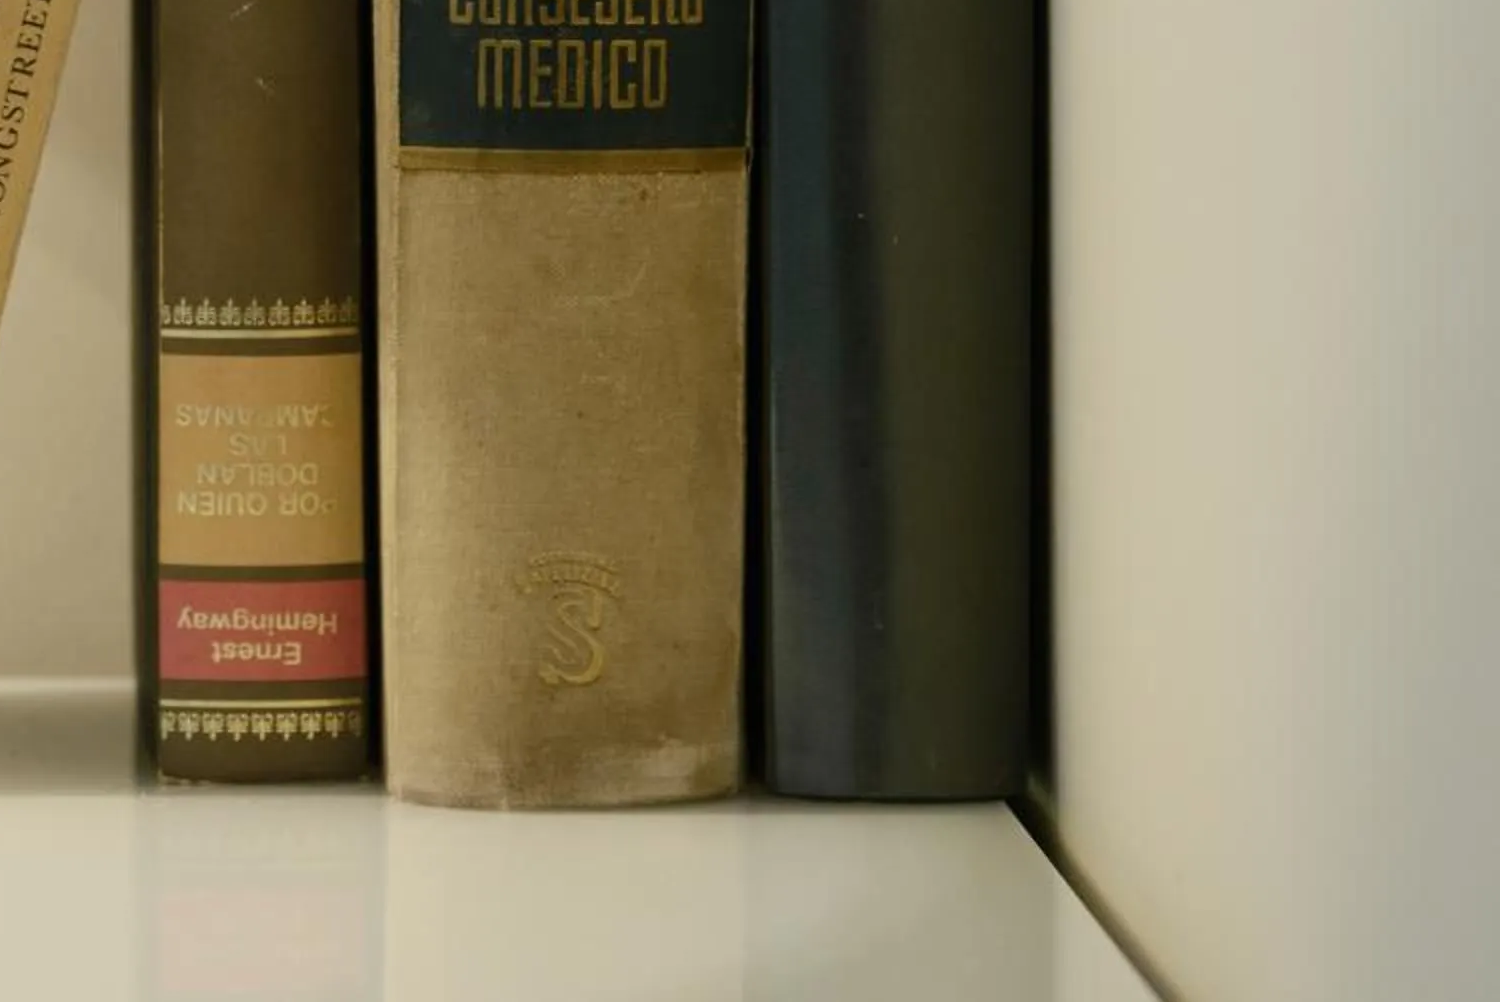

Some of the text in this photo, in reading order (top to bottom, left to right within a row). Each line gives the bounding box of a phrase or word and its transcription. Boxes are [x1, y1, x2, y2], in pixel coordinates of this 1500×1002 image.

[477, 39, 669, 109] MEDICO
[196, 462, 320, 486] DOBLAN
[177, 491, 268, 517] QUIEN
[177, 606, 338, 636] Hemingway
[211, 641, 303, 666] Ernest
